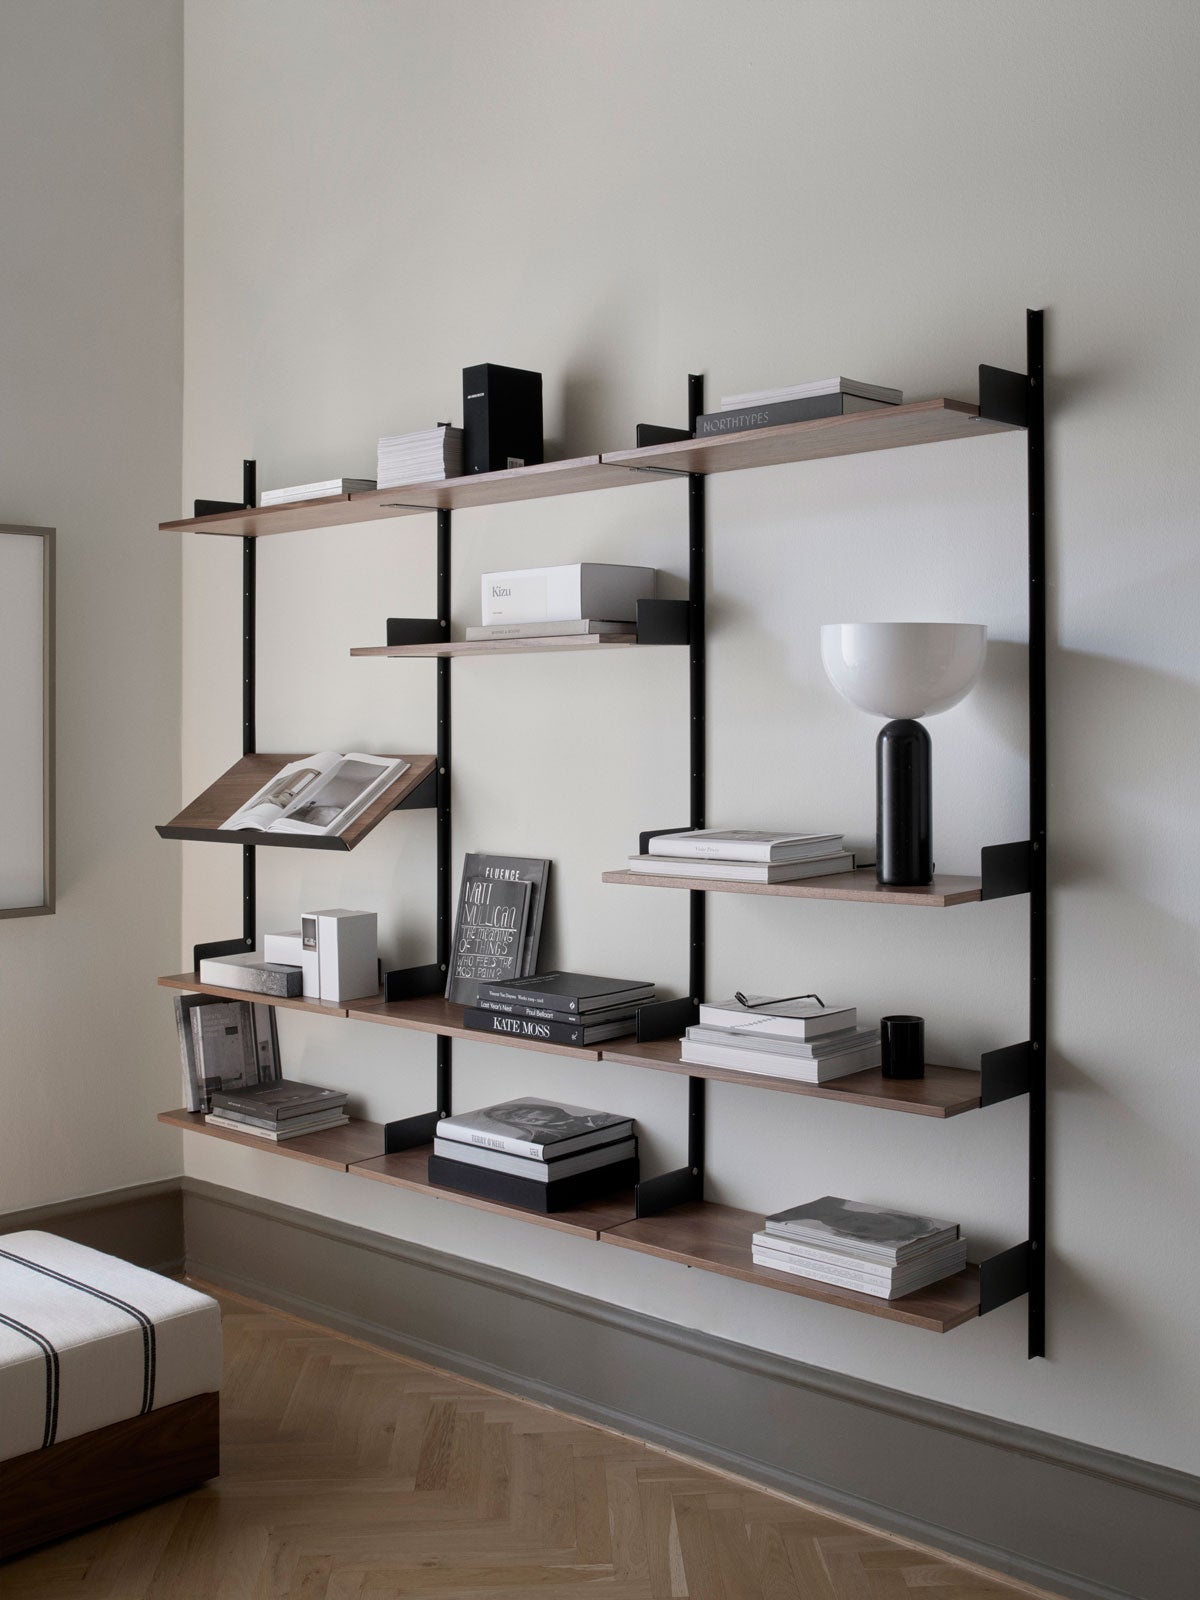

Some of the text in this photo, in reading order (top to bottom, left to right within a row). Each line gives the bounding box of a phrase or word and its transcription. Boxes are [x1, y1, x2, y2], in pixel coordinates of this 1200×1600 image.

[703, 411, 769, 432] NORTHTYPES
[492, 585, 511, 598] Kizu
[485, 867, 520, 881] FLUENCE
[459, 938, 508, 956] OF THINGS
[526, 1008, 536, 1016] Paul
[493, 1016, 550, 1038] KATE MOSS
[471, 1134, 487, 1146] TERRY
